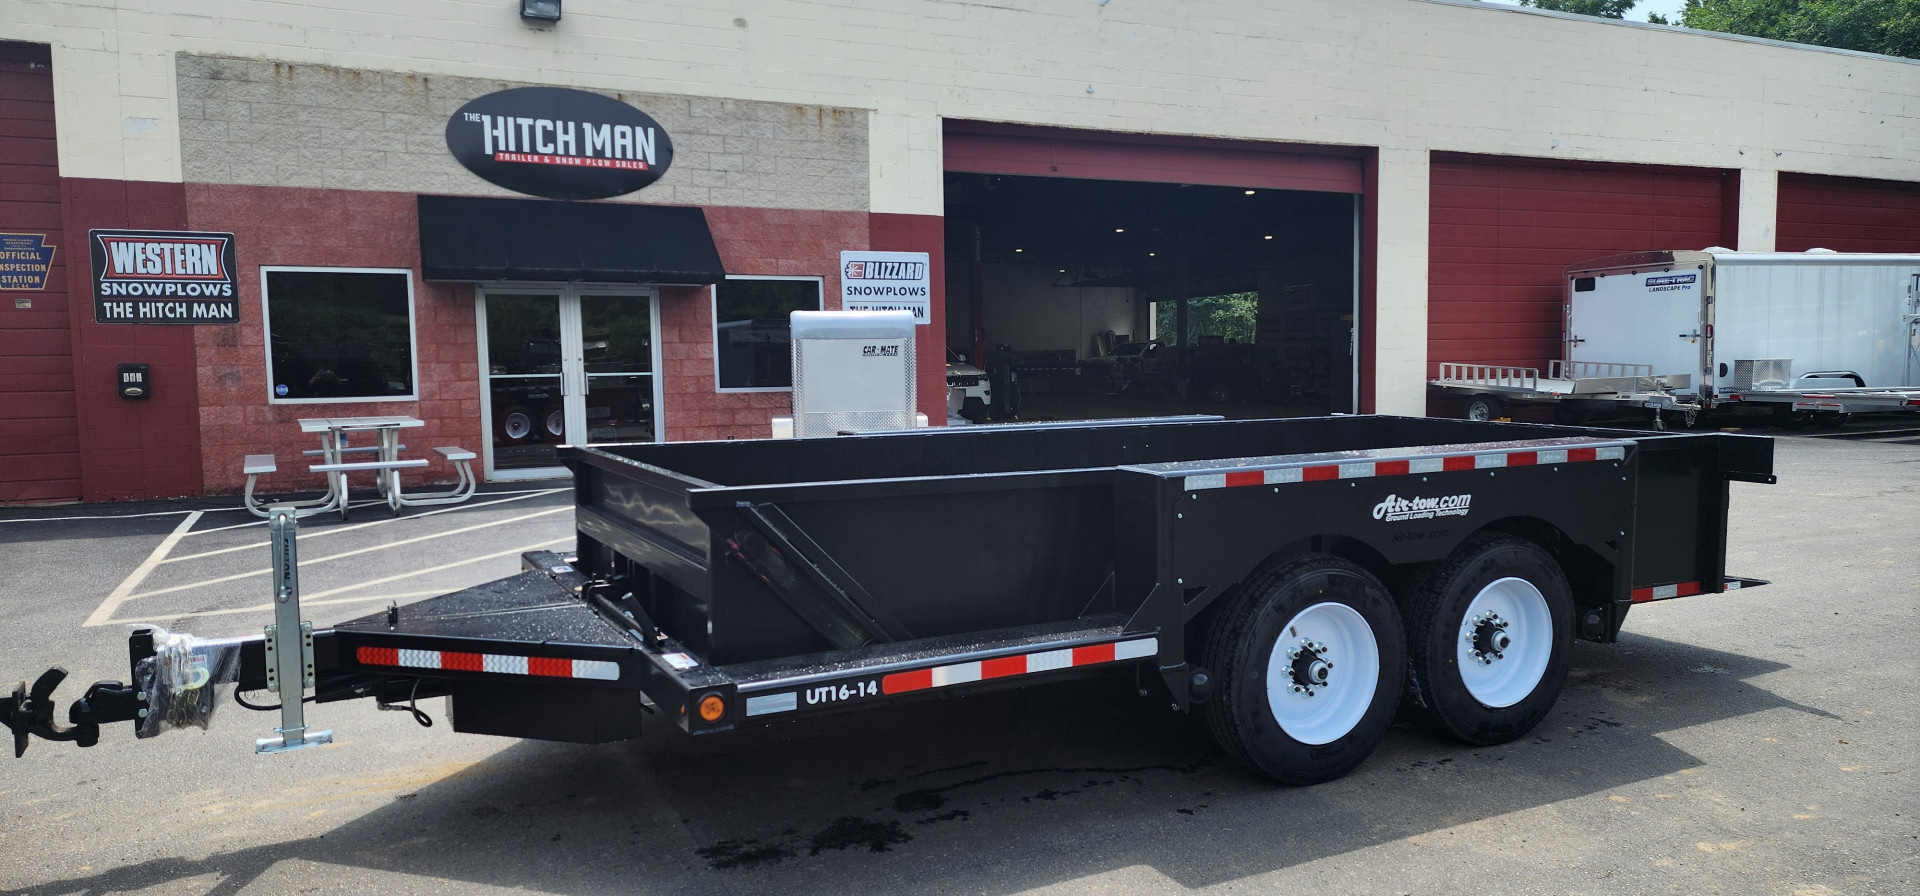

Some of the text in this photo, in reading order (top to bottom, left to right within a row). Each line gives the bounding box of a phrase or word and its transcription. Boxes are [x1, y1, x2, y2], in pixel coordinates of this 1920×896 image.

[463, 112, 481, 122] THE
[481, 114, 656, 165] HITCH MAN
[499, 153, 539, 163] TRAILER
[555, 156, 582, 165] SNOW
[586, 159, 611, 167] PLOW
[615, 161, 644, 169] SALES
[0, 252, 42, 260] OFFICIAL
[109, 241, 218, 276] WESTERN
[0, 264, 47, 272] NSPECTION
[865, 262, 924, 280] BLIZZARD
[1, 275, 40, 284] STATION
[101, 282, 233, 297] SNOWPLOWS
[846, 286, 926, 296] SNOWPLOWS
[103, 302, 233, 318] THE HITCH MAN
[1372, 494, 1472, 520] Air-tow.com
[1385, 508, 1470, 522] Ground Loading Technology
[805, 679, 878, 705] UT16-14
